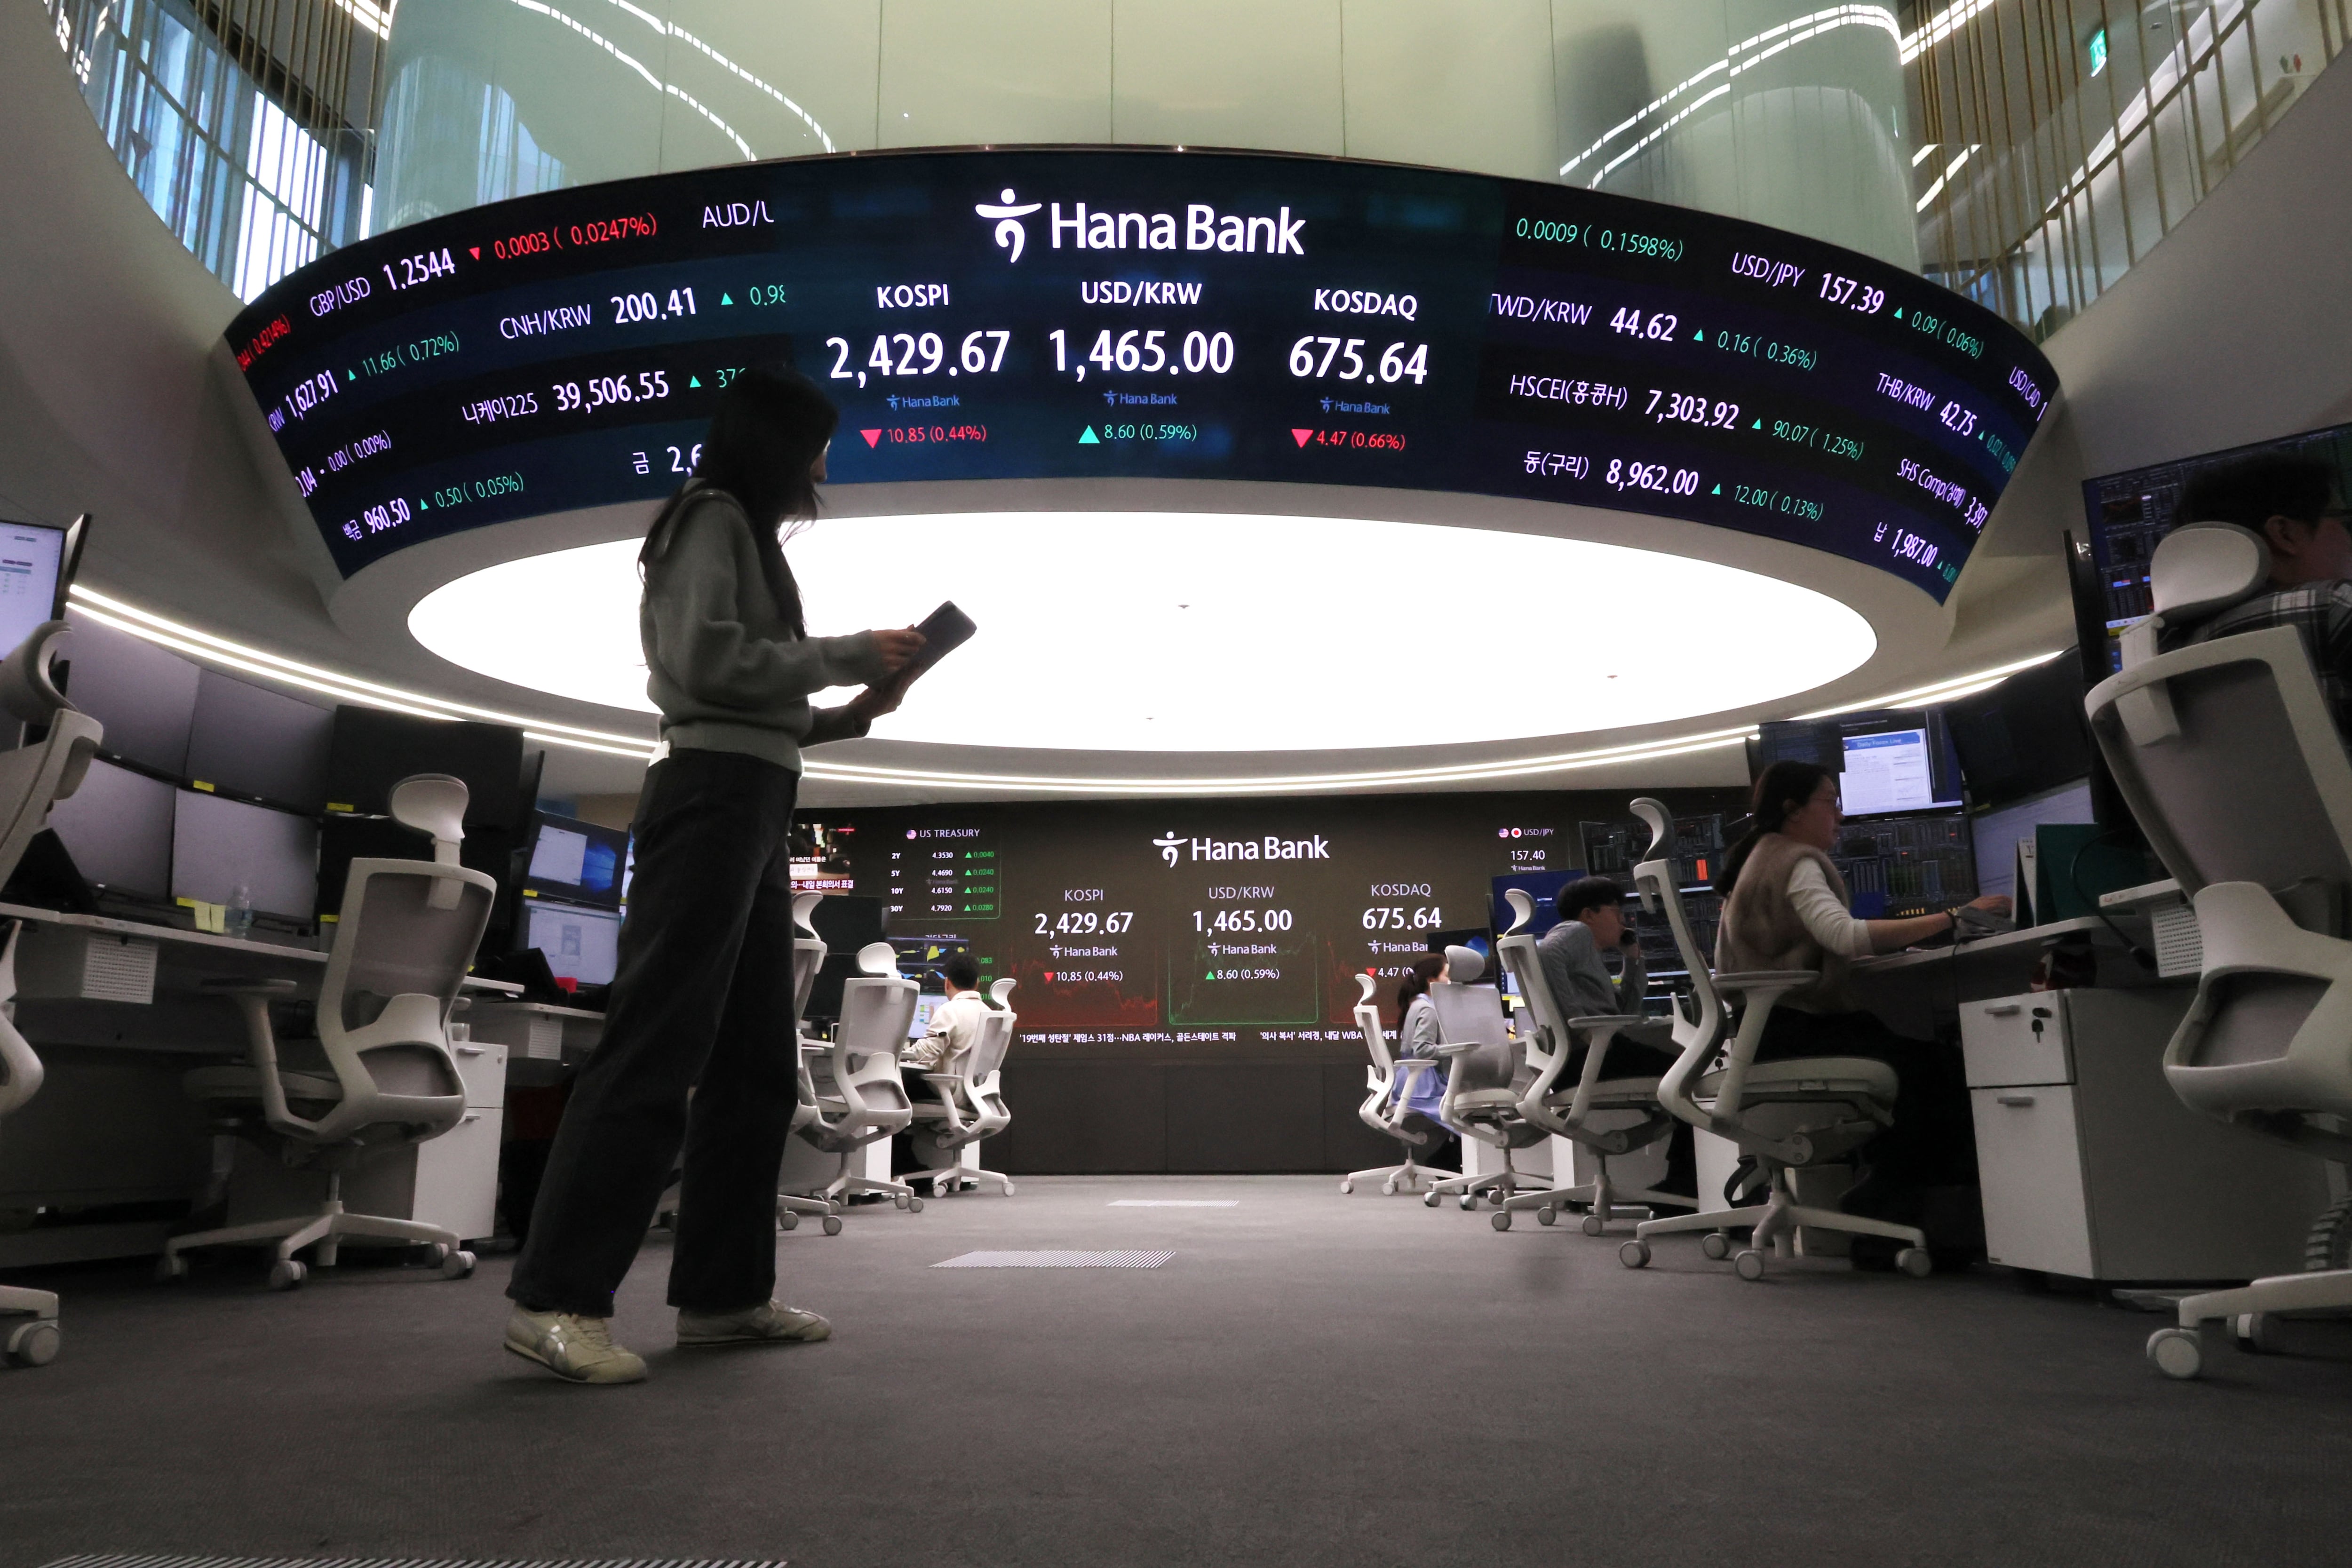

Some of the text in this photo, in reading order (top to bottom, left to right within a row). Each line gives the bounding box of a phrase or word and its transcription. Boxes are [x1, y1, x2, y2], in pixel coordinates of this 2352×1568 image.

[1051, 203, 1305, 255] Hana Bank
[1517, 218, 1577, 242] 0.0009
[310, 277, 370, 316] GBP/USD
[383, 248, 455, 290] 1.2544
[495, 232, 550, 259] 0.0003
[877, 284, 948, 308] KOSPI
[1082, 281, 1202, 306] USD/KRW
[1315, 289, 1417, 321] KOSDAQ
[1732, 253, 1805, 287] USD/JPY
[1820, 273, 1884, 313] 157.39
[1912, 311, 1937, 333] 0.09
[500, 304, 590, 339] CNH/KRW
[611, 287, 696, 324] 200.41
[1610, 307, 1677, 341] 44.62
[1718, 331, 1750, 352] 0.16
[826, 331, 1010, 388] 2,429.67
[1050, 330, 1233, 382] 1,465.00
[1290, 336, 1428, 384] 675.64
[286, 370, 338, 420] 1,627.91
[363, 351, 396, 375] 11.66
[462, 367, 746, 424] 니케이225 39,506.55 37
[2009, 366, 2040, 407] USD/CAD
[903, 395, 959, 407] Hana Bank
[1120, 394, 1176, 404] Hana Bank
[1335, 401, 1390, 414] Hana Bank
[1510, 375, 1627, 410] HSCEI(홍콩H)
[1645, 390, 1739, 429] 7,303.92
[1773, 421, 1809, 442] 90.07
[1877, 373, 1935, 411] THB/KRW
[1940, 401, 1977, 436] 42.75
[889, 426, 986, 442] 10.85 (0.44%)
[1105, 424, 1196, 441] 8.60 (0.59%)
[1317, 431, 1405, 450] 4.47 (0.66%)
[633, 452, 649, 474] 금
[1897, 459, 1920, 481] SHS
[1524, 451, 1589, 479] 동(구리)
[1606, 459, 1699, 495] 8,962.00
[1735, 486, 1767, 506] 12.00
[343, 520, 362, 541] 백금
[364, 498, 410, 533] 960.50
[436, 487, 462, 507] 0.50
[1874, 522, 1887, 542] 납
[1891, 529, 1938, 567] 1,987.00
[1192, 835, 1329, 860] Hana Bank
[1511, 850, 1545, 860] 157.40
[1065, 890, 1103, 901] KOSPI
[1209, 887, 1274, 899] USD/KRW
[1372, 884, 1430, 897] KOSDAQ
[1035, 912, 1133, 939] 2,429.67
[1193, 910, 1292, 937] 1,465.00
[1363, 907, 1441, 930] 675.64
[1065, 947, 1117, 956] Hana Bank
[1223, 944, 1276, 954] Hana Bank
[1383, 942, 1428, 952] Hana Ba
[1057, 971, 1122, 982] 10.85 (0.44%)
[1217, 969, 1279, 979] 8.60 (0.59%)
[1378, 968, 1398, 977] 4.47
[1073, 1034, 1095, 1043] 제임스
[1143, 1033, 1174, 1043] 레이커스,
[1176, 1033, 1219, 1042] 골든스테이트
[1222, 1032, 1236, 1041] 격파
[1325, 1031, 1339, 1040] 내달
